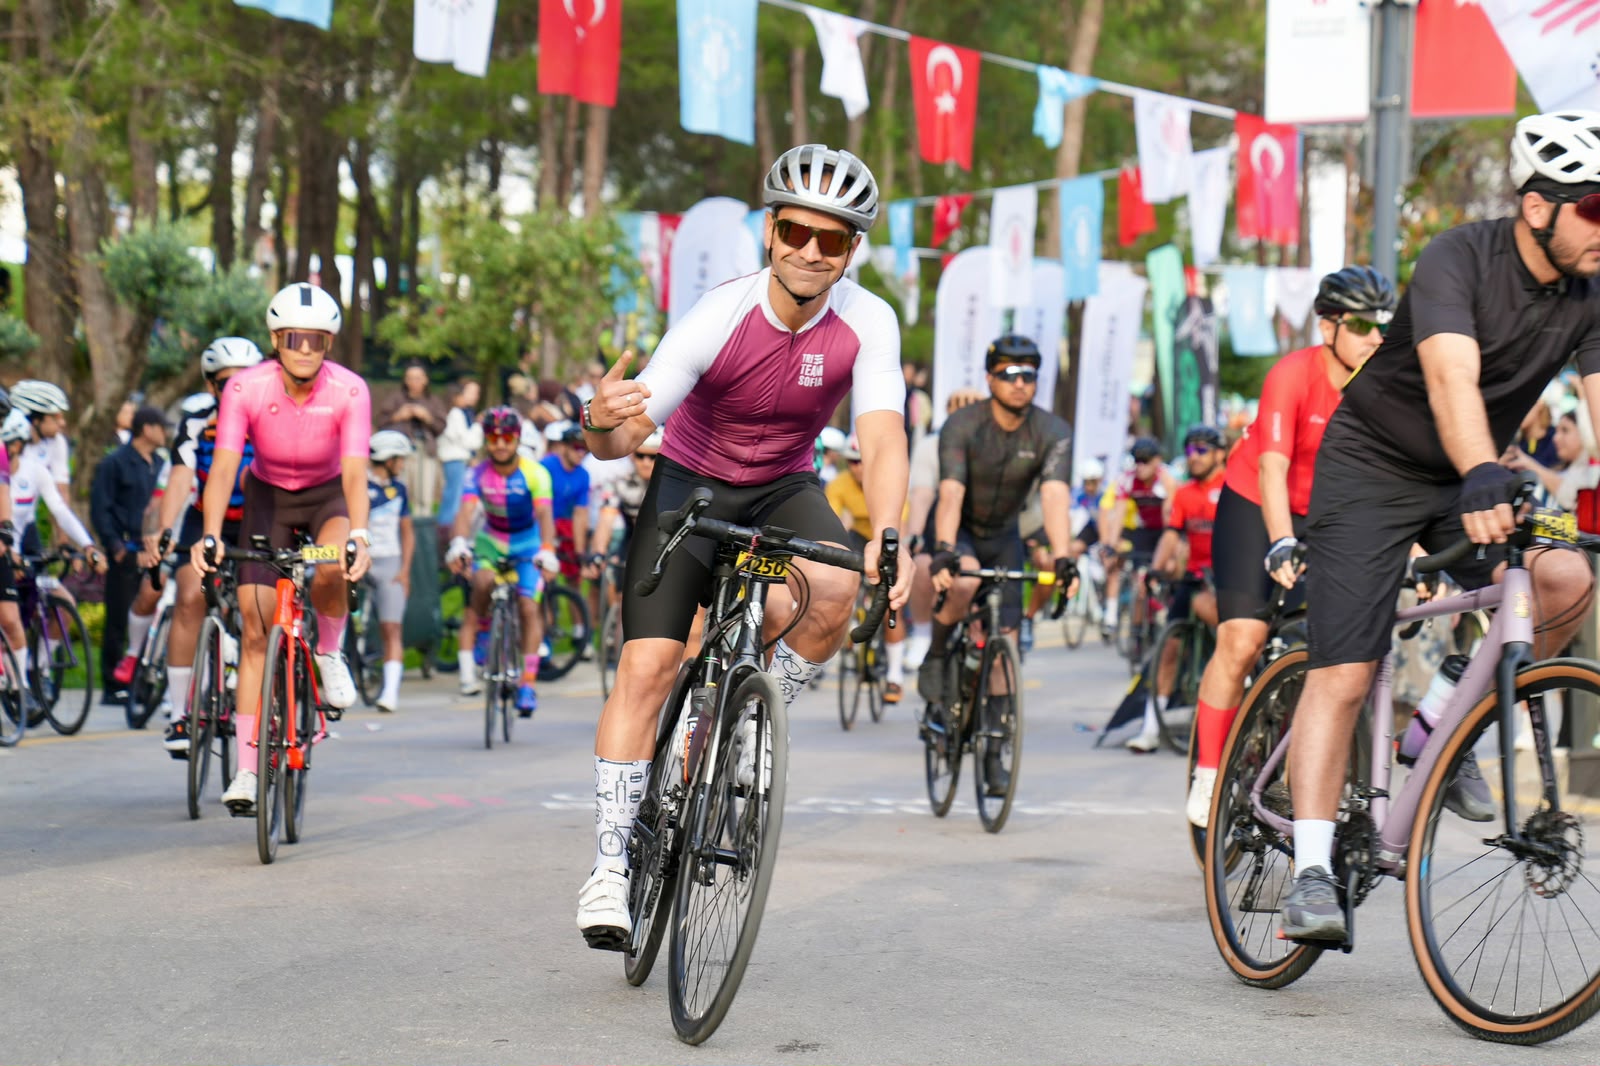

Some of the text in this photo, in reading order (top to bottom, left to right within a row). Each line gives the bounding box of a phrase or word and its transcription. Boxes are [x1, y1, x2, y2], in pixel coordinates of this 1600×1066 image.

[802, 353, 814, 363] TRI
[800, 364, 823, 376] TEAM
[798, 375, 823, 386] SOFIA
